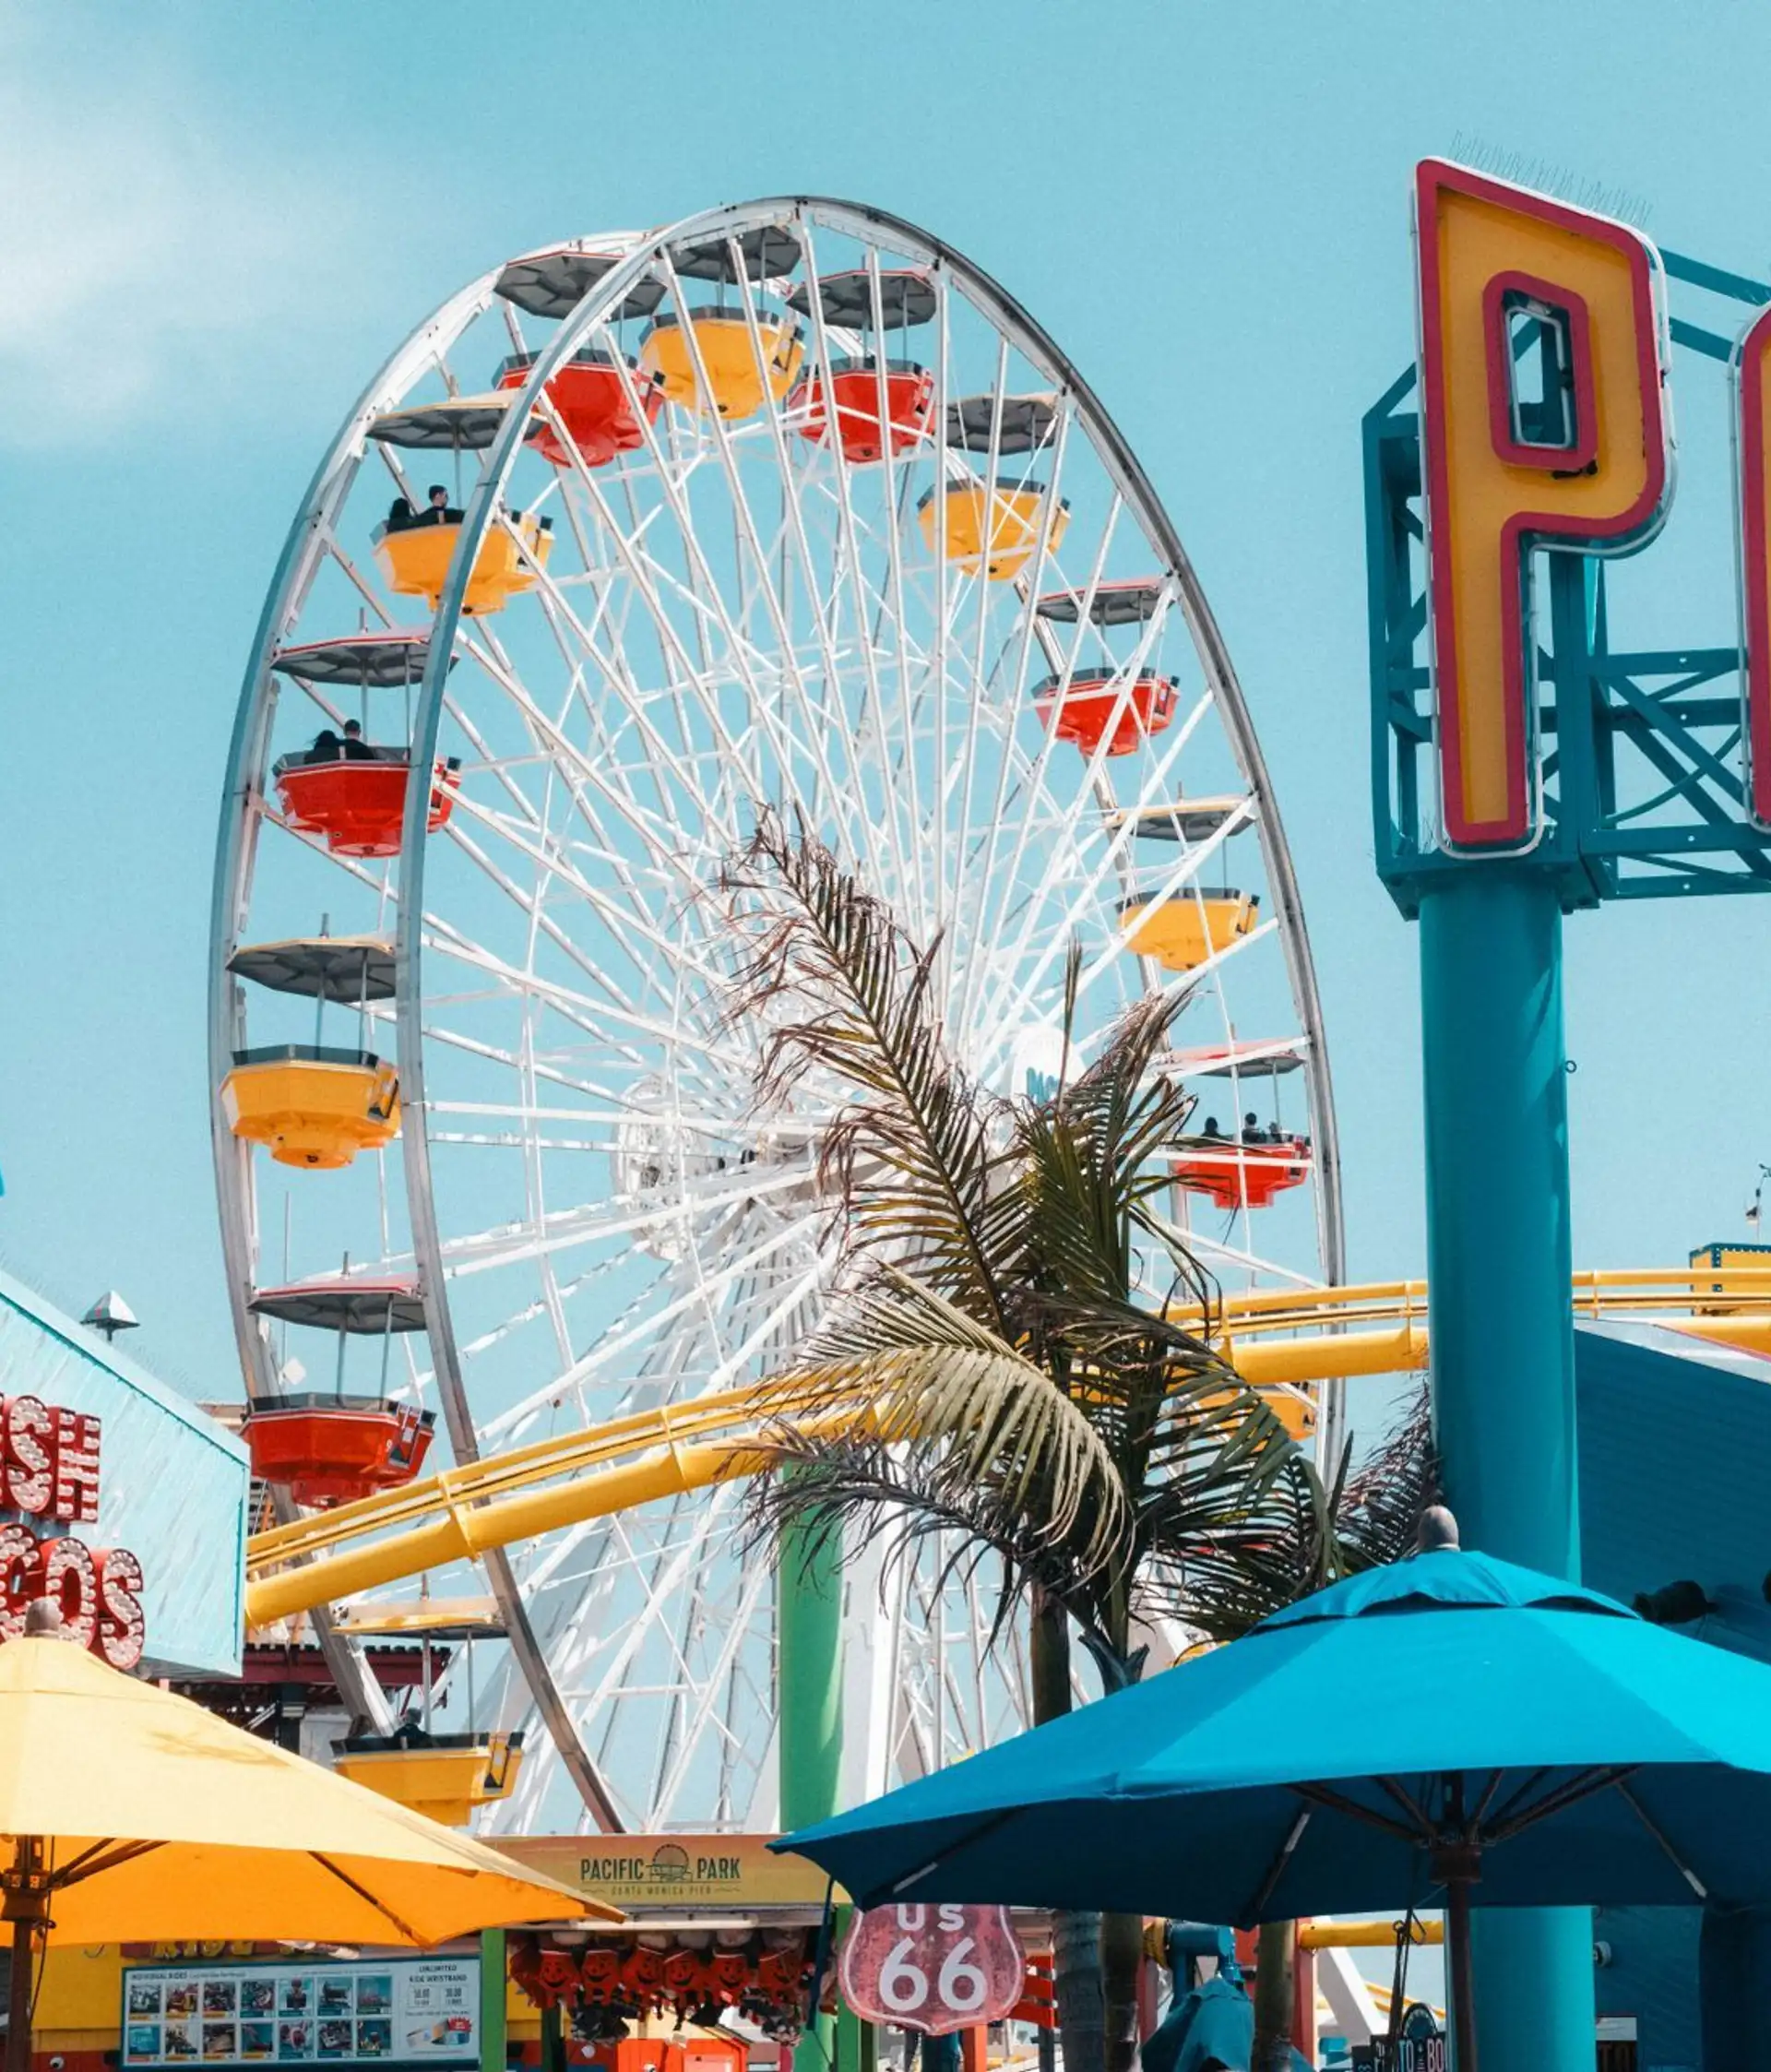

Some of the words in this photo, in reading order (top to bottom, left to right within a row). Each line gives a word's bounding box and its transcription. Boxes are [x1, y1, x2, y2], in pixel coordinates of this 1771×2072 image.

[1416, 156, 1771, 861] P
[0, 1395, 101, 1524] SH
[580, 1858, 644, 1880] PACIFIC
[696, 1858, 741, 1879] PARK
[897, 1902, 965, 1932] US
[878, 1936, 988, 2012] 66
